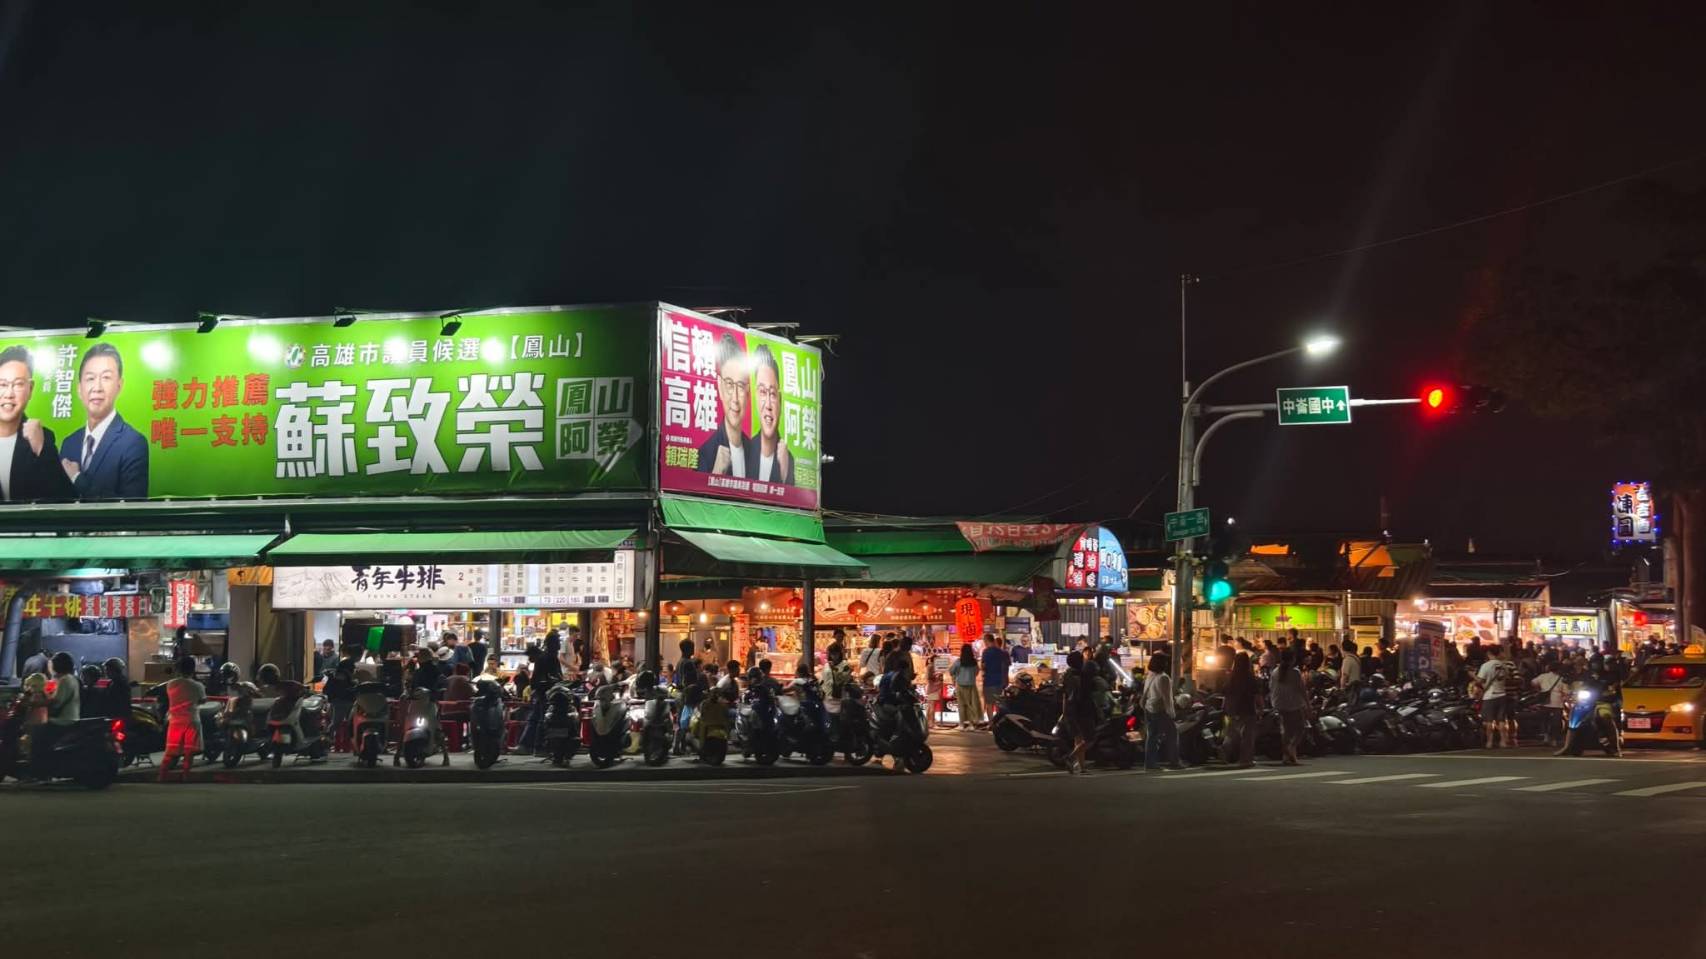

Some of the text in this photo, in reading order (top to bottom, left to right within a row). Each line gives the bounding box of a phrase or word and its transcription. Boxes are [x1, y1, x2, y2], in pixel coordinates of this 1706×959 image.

[311, 332, 584, 368] 高雄市議員候選【鳳山】
[664, 318, 717, 378] 信賴
[52, 344, 77, 418] 許智傑
[151, 374, 270, 411] 強力推薦
[781, 351, 817, 401] 鳳山
[559, 379, 633, 416] 鳳山
[664, 376, 718, 432] 高雄
[1283, 397, 1334, 415] 中崙國中
[150, 413, 268, 449] 唯一支持
[275, 371, 545, 478] 蘇致榮
[559, 419, 629, 456] 阿榮
[783, 400, 817, 450] 阿榮
[351, 565, 445, 592] 青年牛排
